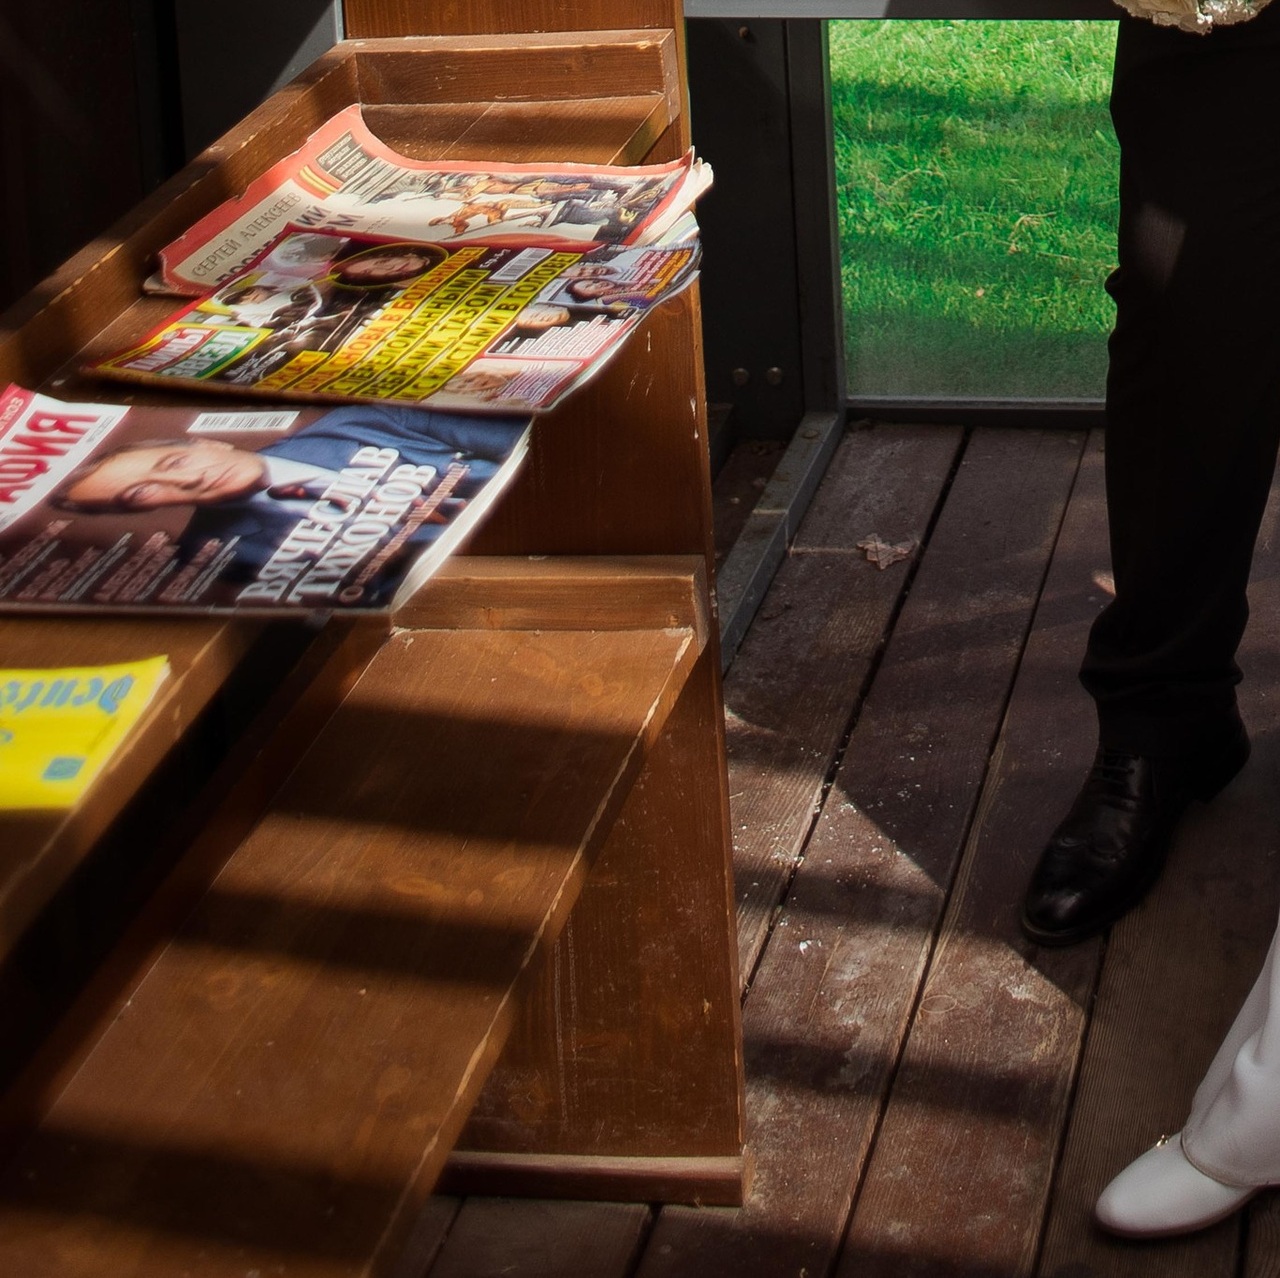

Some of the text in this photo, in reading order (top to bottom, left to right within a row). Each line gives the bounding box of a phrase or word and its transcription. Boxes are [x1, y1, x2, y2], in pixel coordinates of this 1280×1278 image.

[190, 238, 243, 276] СЕРГЕЙ
[237, 192, 304, 238] АЛЕКСЕЕВ
[391, 248, 485, 309] БОЛЬНИЦЕ!
[495, 302, 520, 311] В
[506, 253, 576, 298] ГОЛОВЕ!
[329, 327, 393, 367] СНОВА
[346, 269, 484, 383] ПЕРЕЛОМАННЫМИ
[364, 336, 458, 396] РЕБРАМИ,
[441, 285, 503, 332] ТАЗОМ
[382, 313, 403, 321] В
[422, 315, 503, 379] КИСТАМИ
[122, 327, 213, 370] ТАЙНЫ
[236, 446, 400, 603] ВЯЧЕСЛАВ
[287, 463, 437, 604] ТИХОНОВ
